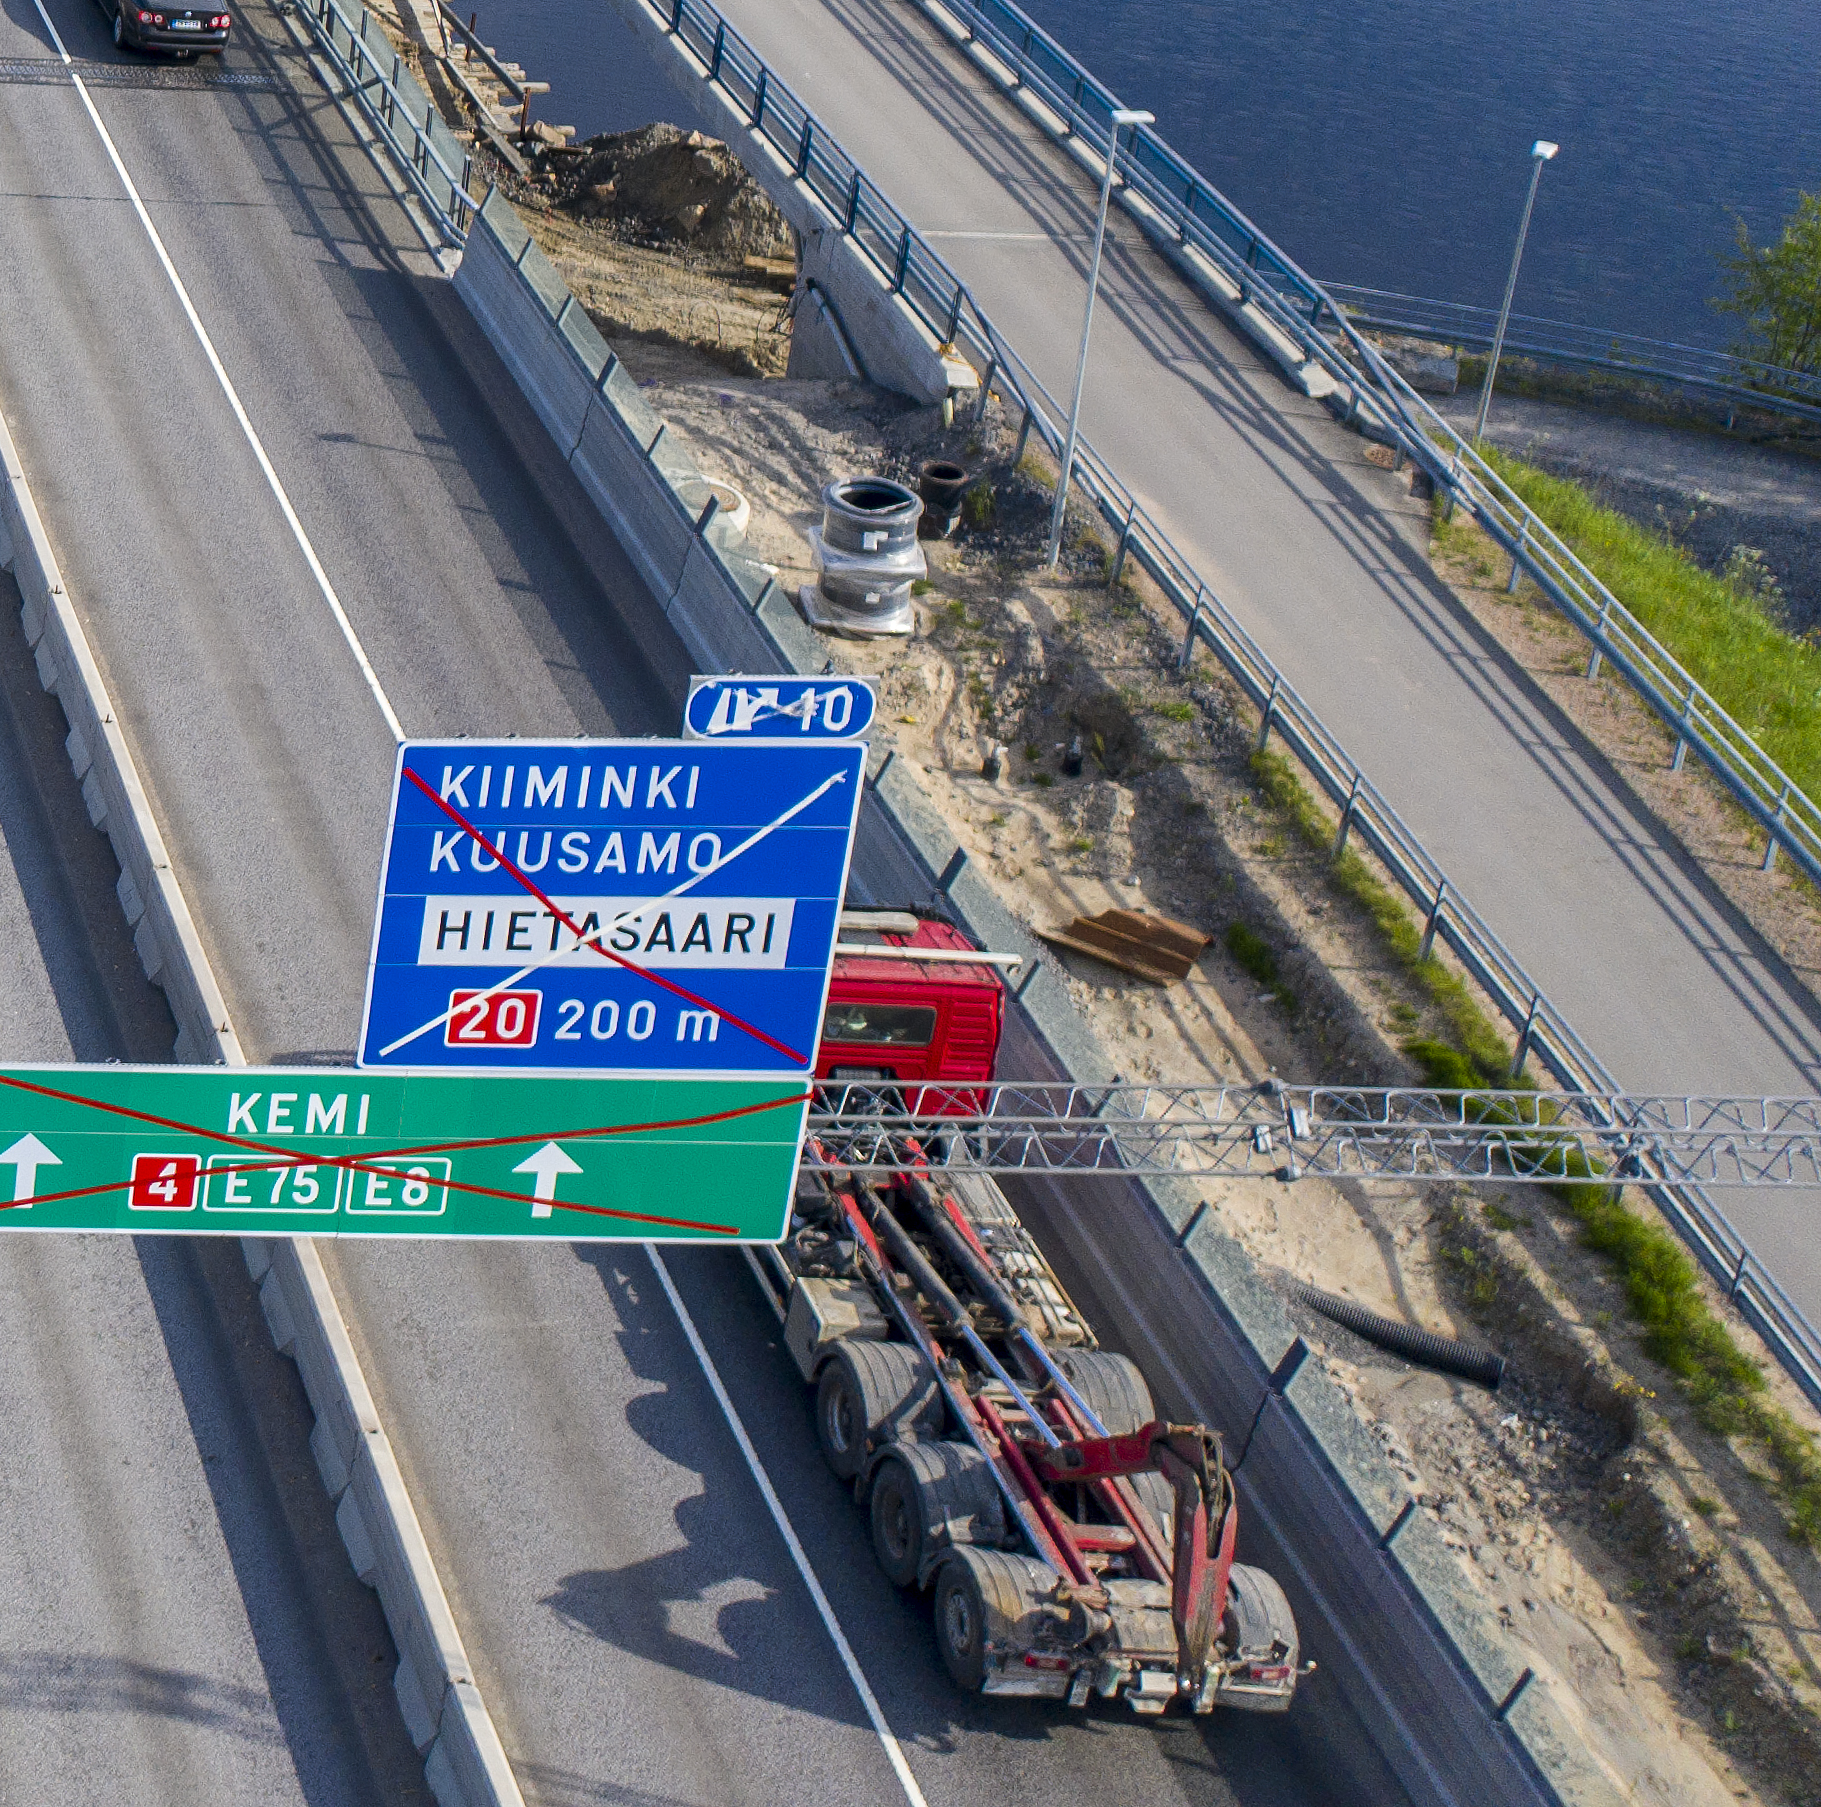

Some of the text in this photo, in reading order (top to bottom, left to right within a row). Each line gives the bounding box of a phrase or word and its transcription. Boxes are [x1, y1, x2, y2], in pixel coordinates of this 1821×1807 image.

[801, 687, 853, 732] 10
[439, 765, 700, 809] KIIMINKI
[429, 830, 723, 875] KUUSAMO
[435, 909, 776, 954] HIETASAARI
[458, 997, 721, 1042] 20 200 m
[227, 1092, 370, 1135] KEMI
[147, 1162, 178, 1203] 4
